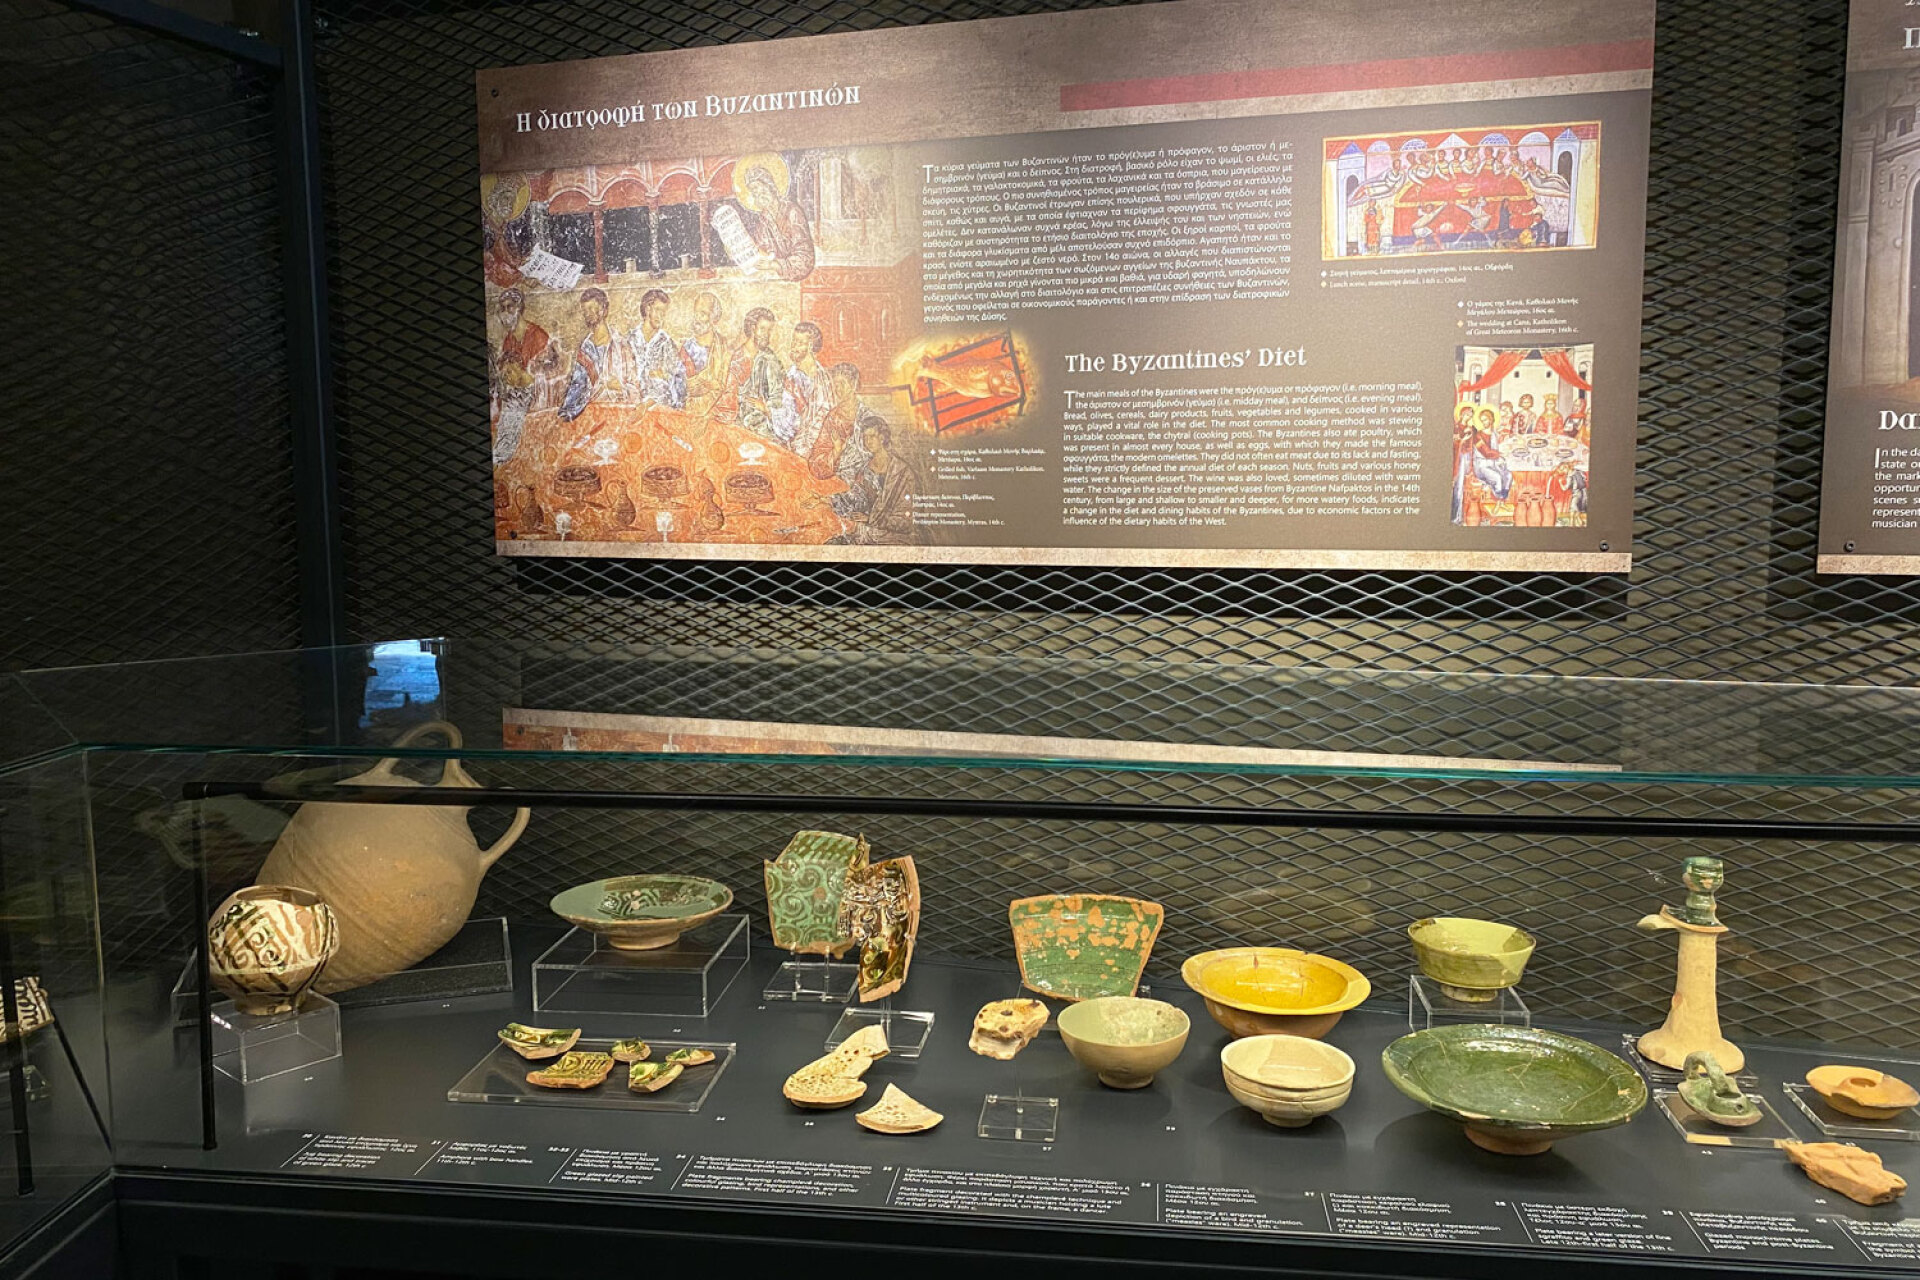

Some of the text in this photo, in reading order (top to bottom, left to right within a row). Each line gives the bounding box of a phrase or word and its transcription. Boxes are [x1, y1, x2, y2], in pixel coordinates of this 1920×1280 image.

[517, 112, 532, 132] Η
[537, 100, 645, 130] διατροφή
[652, 100, 698, 120] των
[1065, 353, 1105, 373] The
[1258, 344, 1307, 367] Diet
[1064, 410, 1087, 420] Bread,
[1116, 409, 1146, 420] cereals,
[1148, 409, 1168, 420] dairy
[1237, 408, 1281, 419] vegetables
[1284, 407, 1300, 416] and
[1304, 406, 1342, 418] legumes,
[1345, 406, 1376, 415] cooked
[1380, 405, 1388, 414] in
[1391, 405, 1422, 414] various
[1086, 421, 1113, 431] played
[1123, 420, 1140, 429] vital
[1143, 420, 1159, 429] role
[1162, 420, 1170, 429] in
[1172, 420, 1186, 429] the
[1210, 419, 1225, 428] The
[1228, 419, 1250, 428] most
[1253, 420, 1290, 428] common
[1293, 418, 1327, 429] cooking
[1330, 417, 1365, 426] method
[1388, 416, 1422, 427] stewing
[1064, 432, 1071, 441] in
[1073, 431, 1103, 440] suitable
[1105, 431, 1145, 441] cookware,
[1148, 431, 1161, 440] the
[1193, 430, 1228, 441] (cooking
[1257, 430, 1272, 439] The
[1275, 429, 1320, 440] Byzantines
[1323, 428, 1340, 438] also
[1343, 428, 1357, 437] ate
[1360, 428, 1393, 439] poultry,
[1396, 427, 1421, 436] which
[1080, 442, 1109, 453] present
[1112, 442, 1119, 451] in
[1122, 441, 1149, 451] almost
[1151, 443, 1173, 452] every
[1216, 441, 1233, 450] well
[1273, 440, 1291, 449] with
[1294, 440, 1319, 449] which
[1322, 440, 1341, 450] they
[1344, 439, 1368, 448] made
[1372, 439, 1386, 448] the
[1389, 438, 1421, 448] famous
[1891, 448, 1908, 456] the
[1881, 460, 1906, 469] state
[1875, 472, 1892, 480] the
[1873, 496, 1907, 504] scenes
[1064, 516, 1226, 527] influence of the dietary habits of the West.
[1872, 518, 1917, 528] musician
